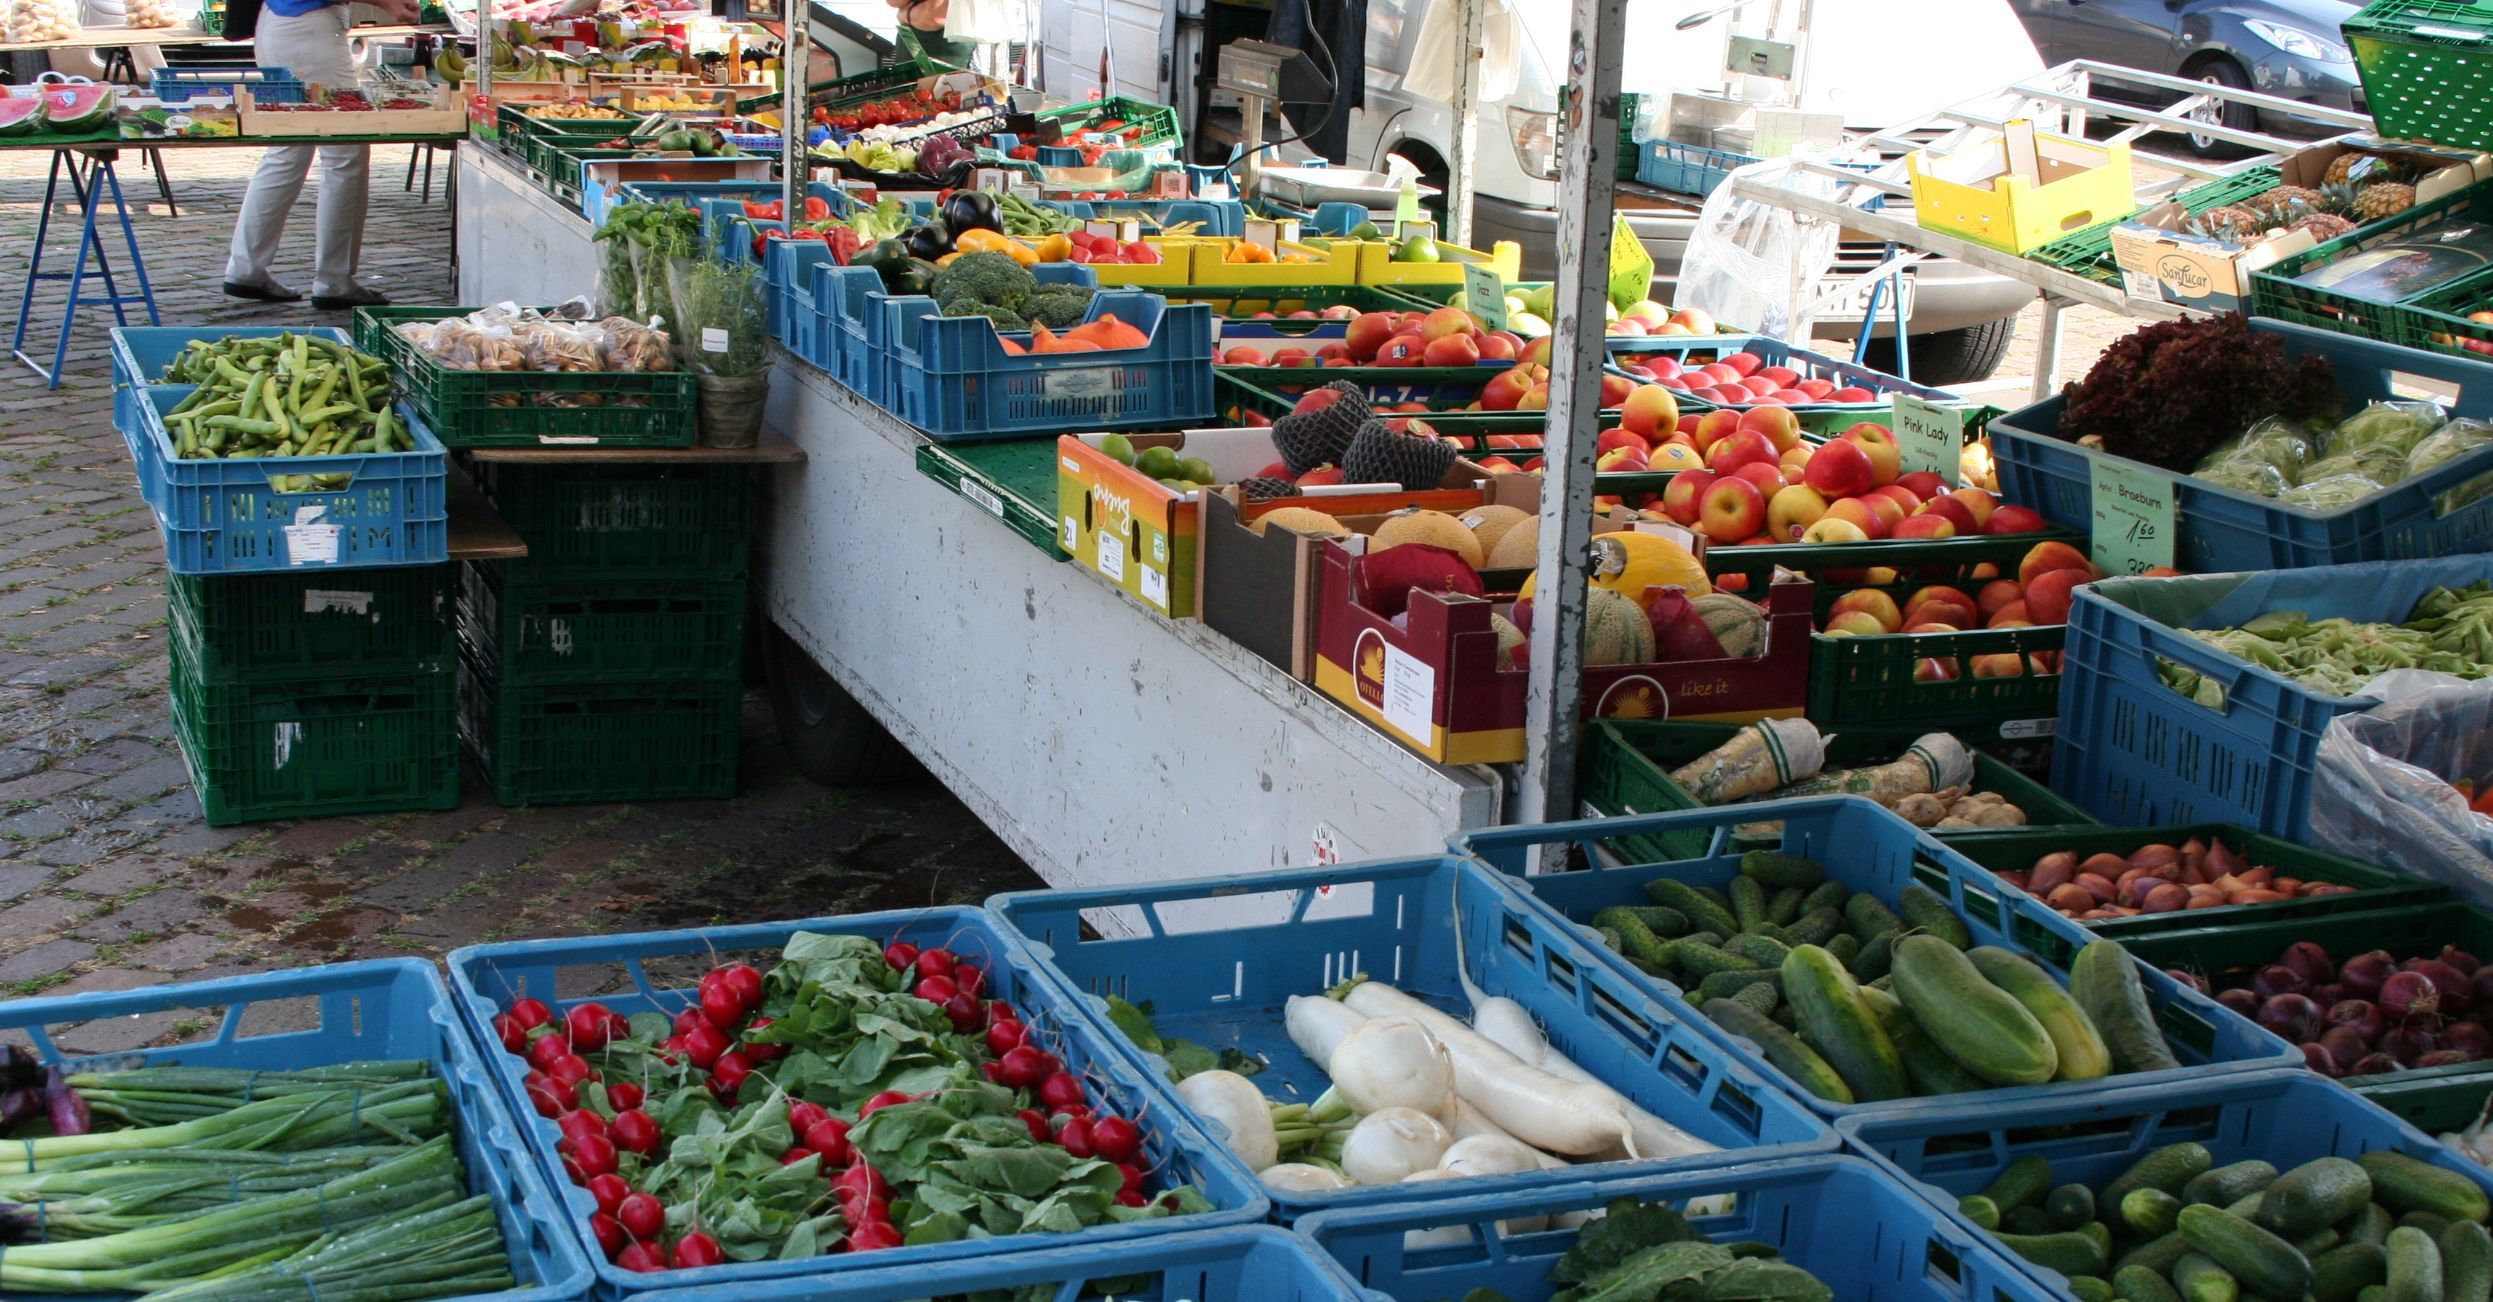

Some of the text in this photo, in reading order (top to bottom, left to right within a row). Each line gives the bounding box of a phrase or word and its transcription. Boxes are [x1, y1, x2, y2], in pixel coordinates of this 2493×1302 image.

[2161, 265, 2208, 289] SanLucar
[1904, 416, 1949, 446] Pink Lady
[2119, 484, 2162, 510] Braeburn
[1681, 678, 1729, 697] like it
